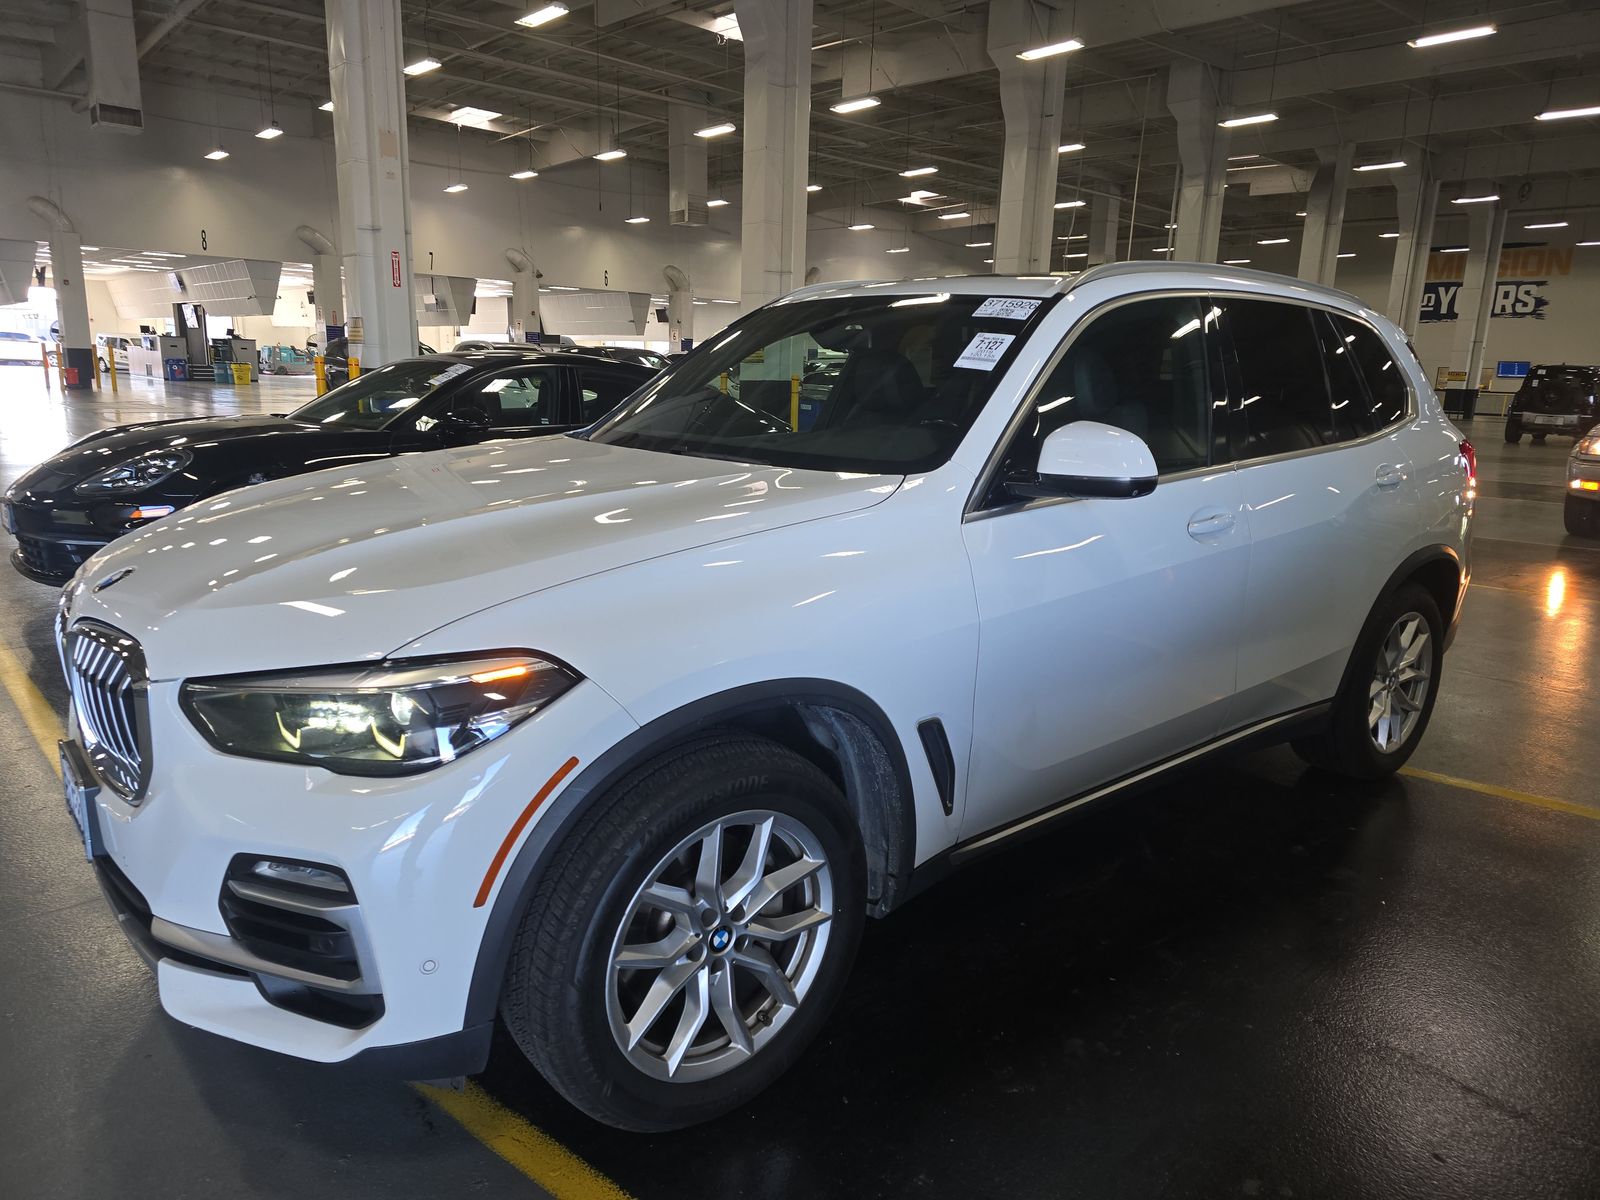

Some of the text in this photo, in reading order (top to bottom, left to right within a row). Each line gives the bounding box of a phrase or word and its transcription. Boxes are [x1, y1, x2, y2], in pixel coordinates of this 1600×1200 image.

[200, 229, 208, 251] 8
[1425, 248, 1574, 280] MISION
[603, 269, 609, 287] 6
[984, 299, 1039, 309] 3715926
[1438, 284, 1538, 314] YRS
